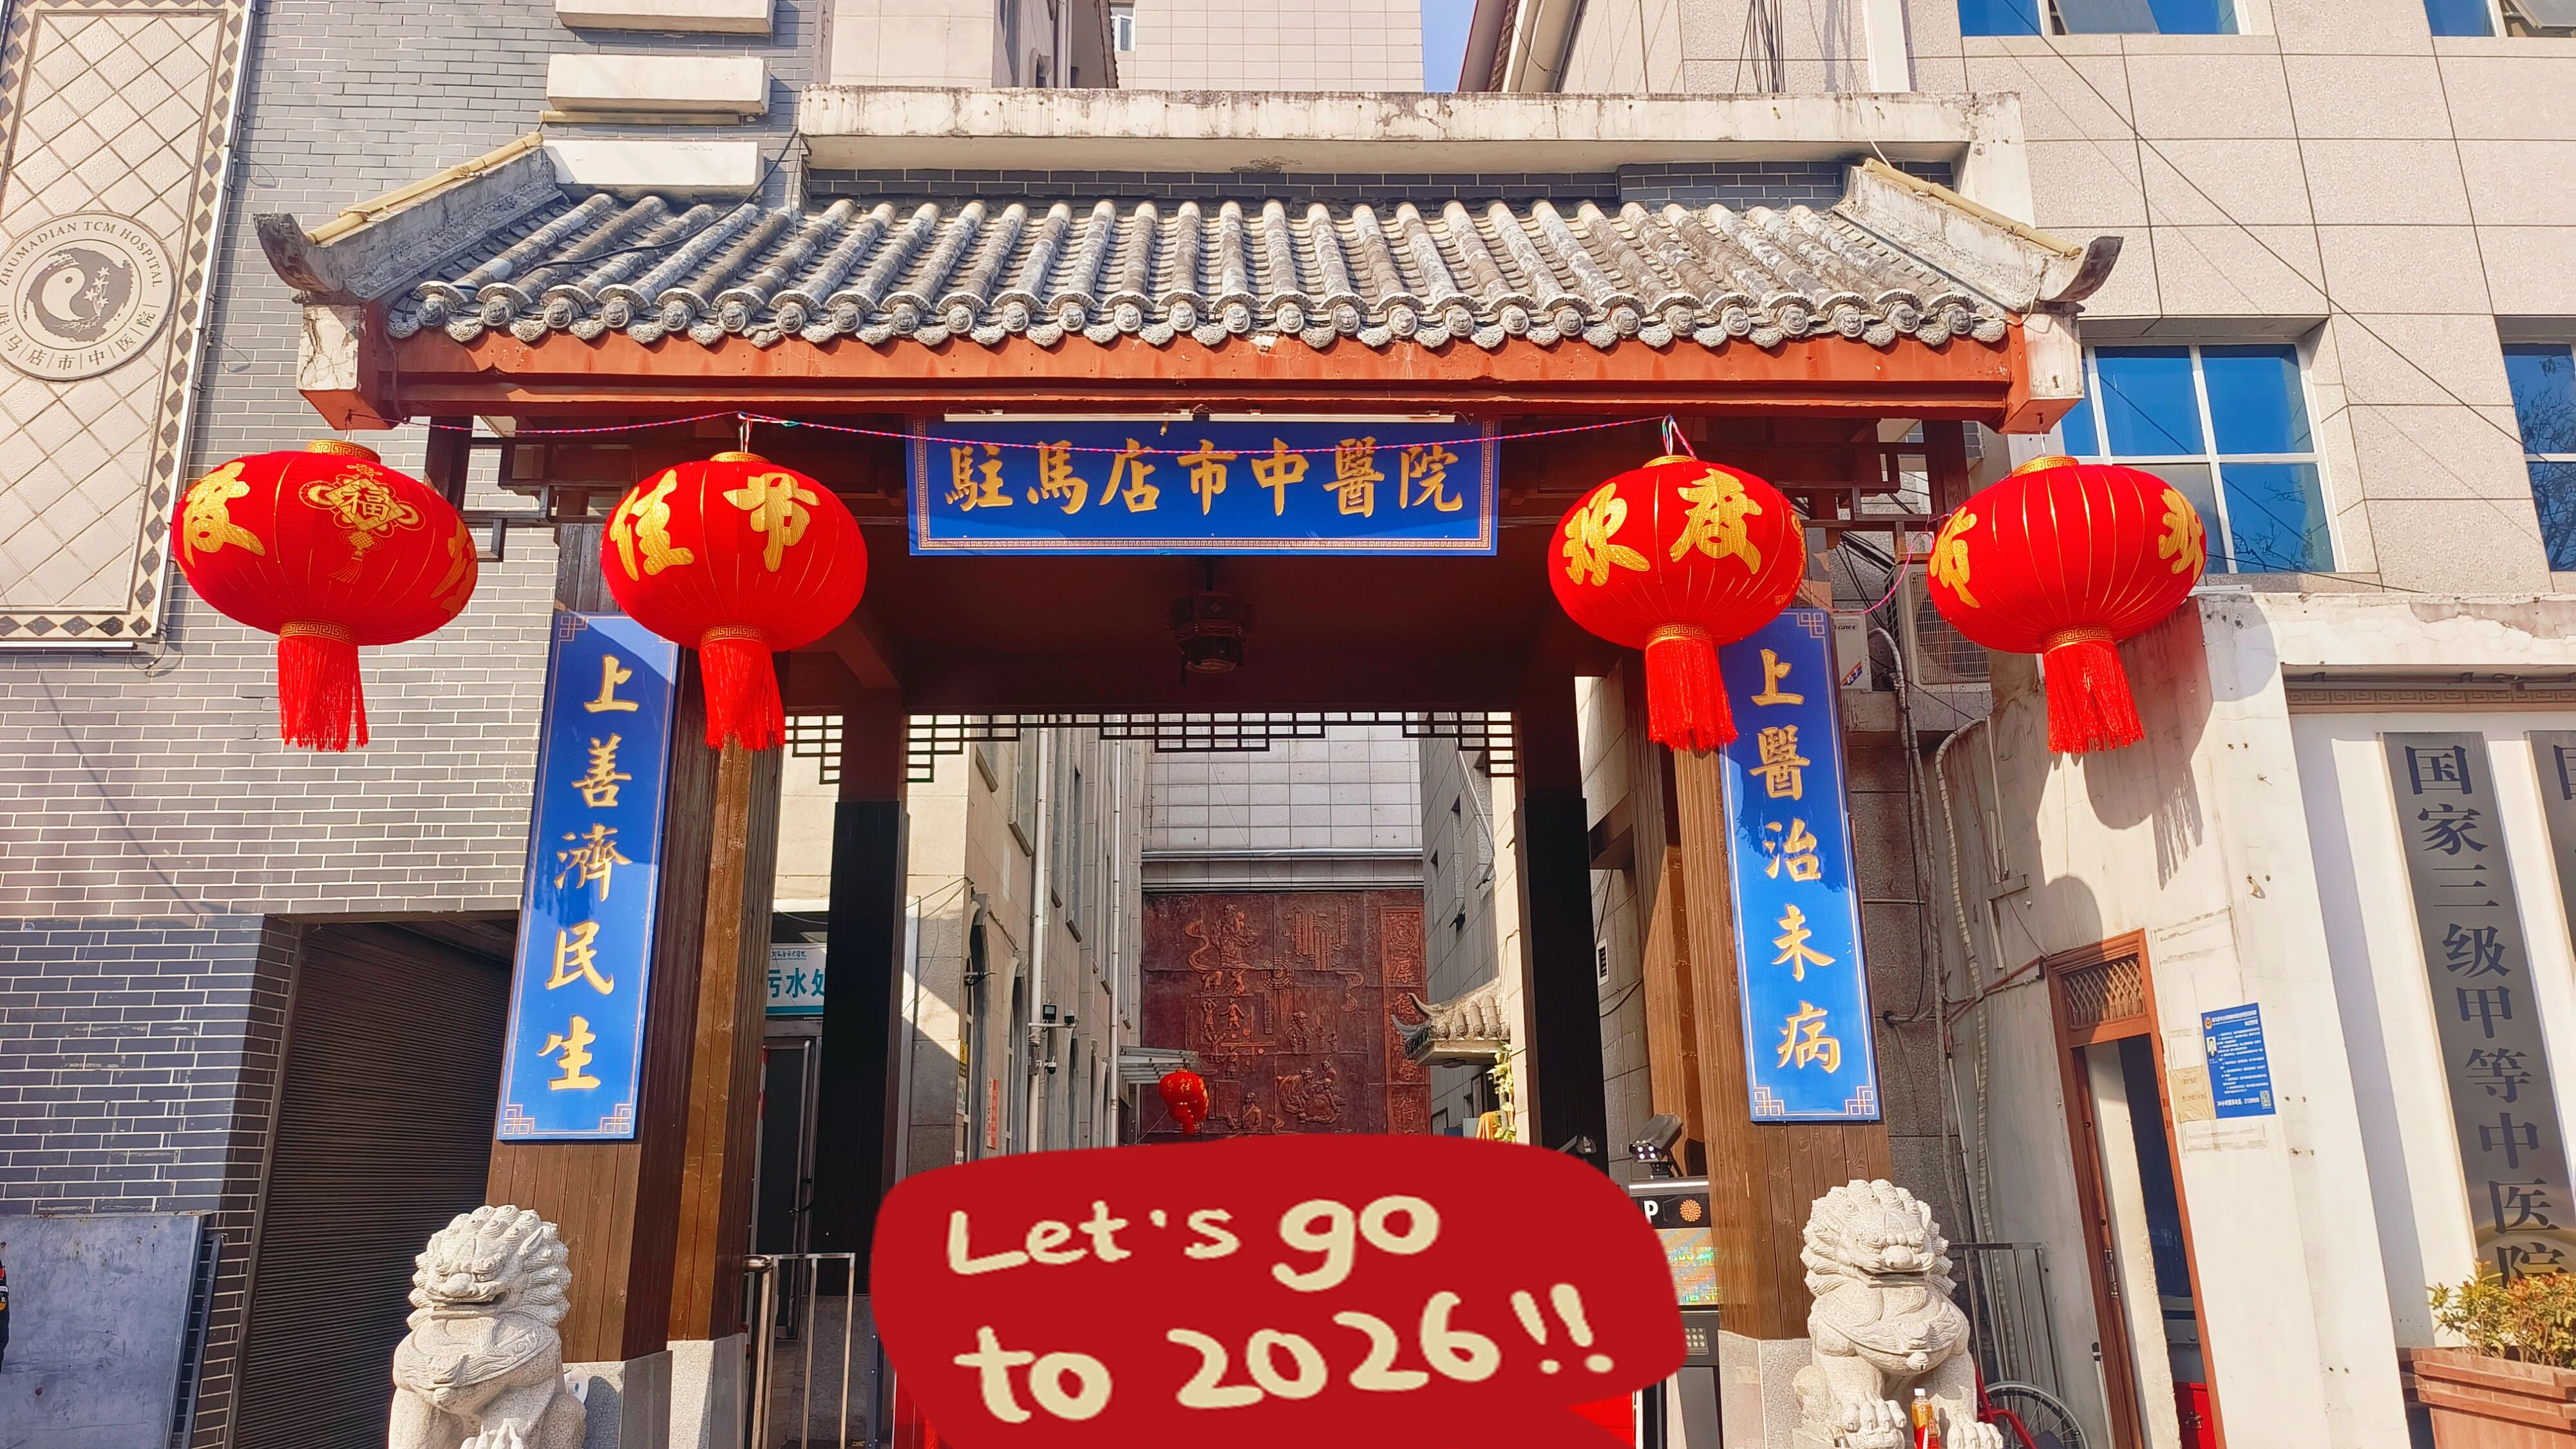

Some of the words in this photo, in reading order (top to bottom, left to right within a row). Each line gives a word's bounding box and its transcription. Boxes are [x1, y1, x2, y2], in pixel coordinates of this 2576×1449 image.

[0, 222, 77, 286] ZHUMADIAN
[84, 221, 117, 234] TCM
[119, 228, 164, 288] HOSPITAL
[343, 486, 390, 520] 福
[946, 436, 1464, 518] 駐馬店市中醫院
[536, 654, 639, 1090] 上善濟民生
[1748, 648, 1841, 1074] 上醫治未病
[2404, 744, 2569, 1289] 国家三级甲等中医院
